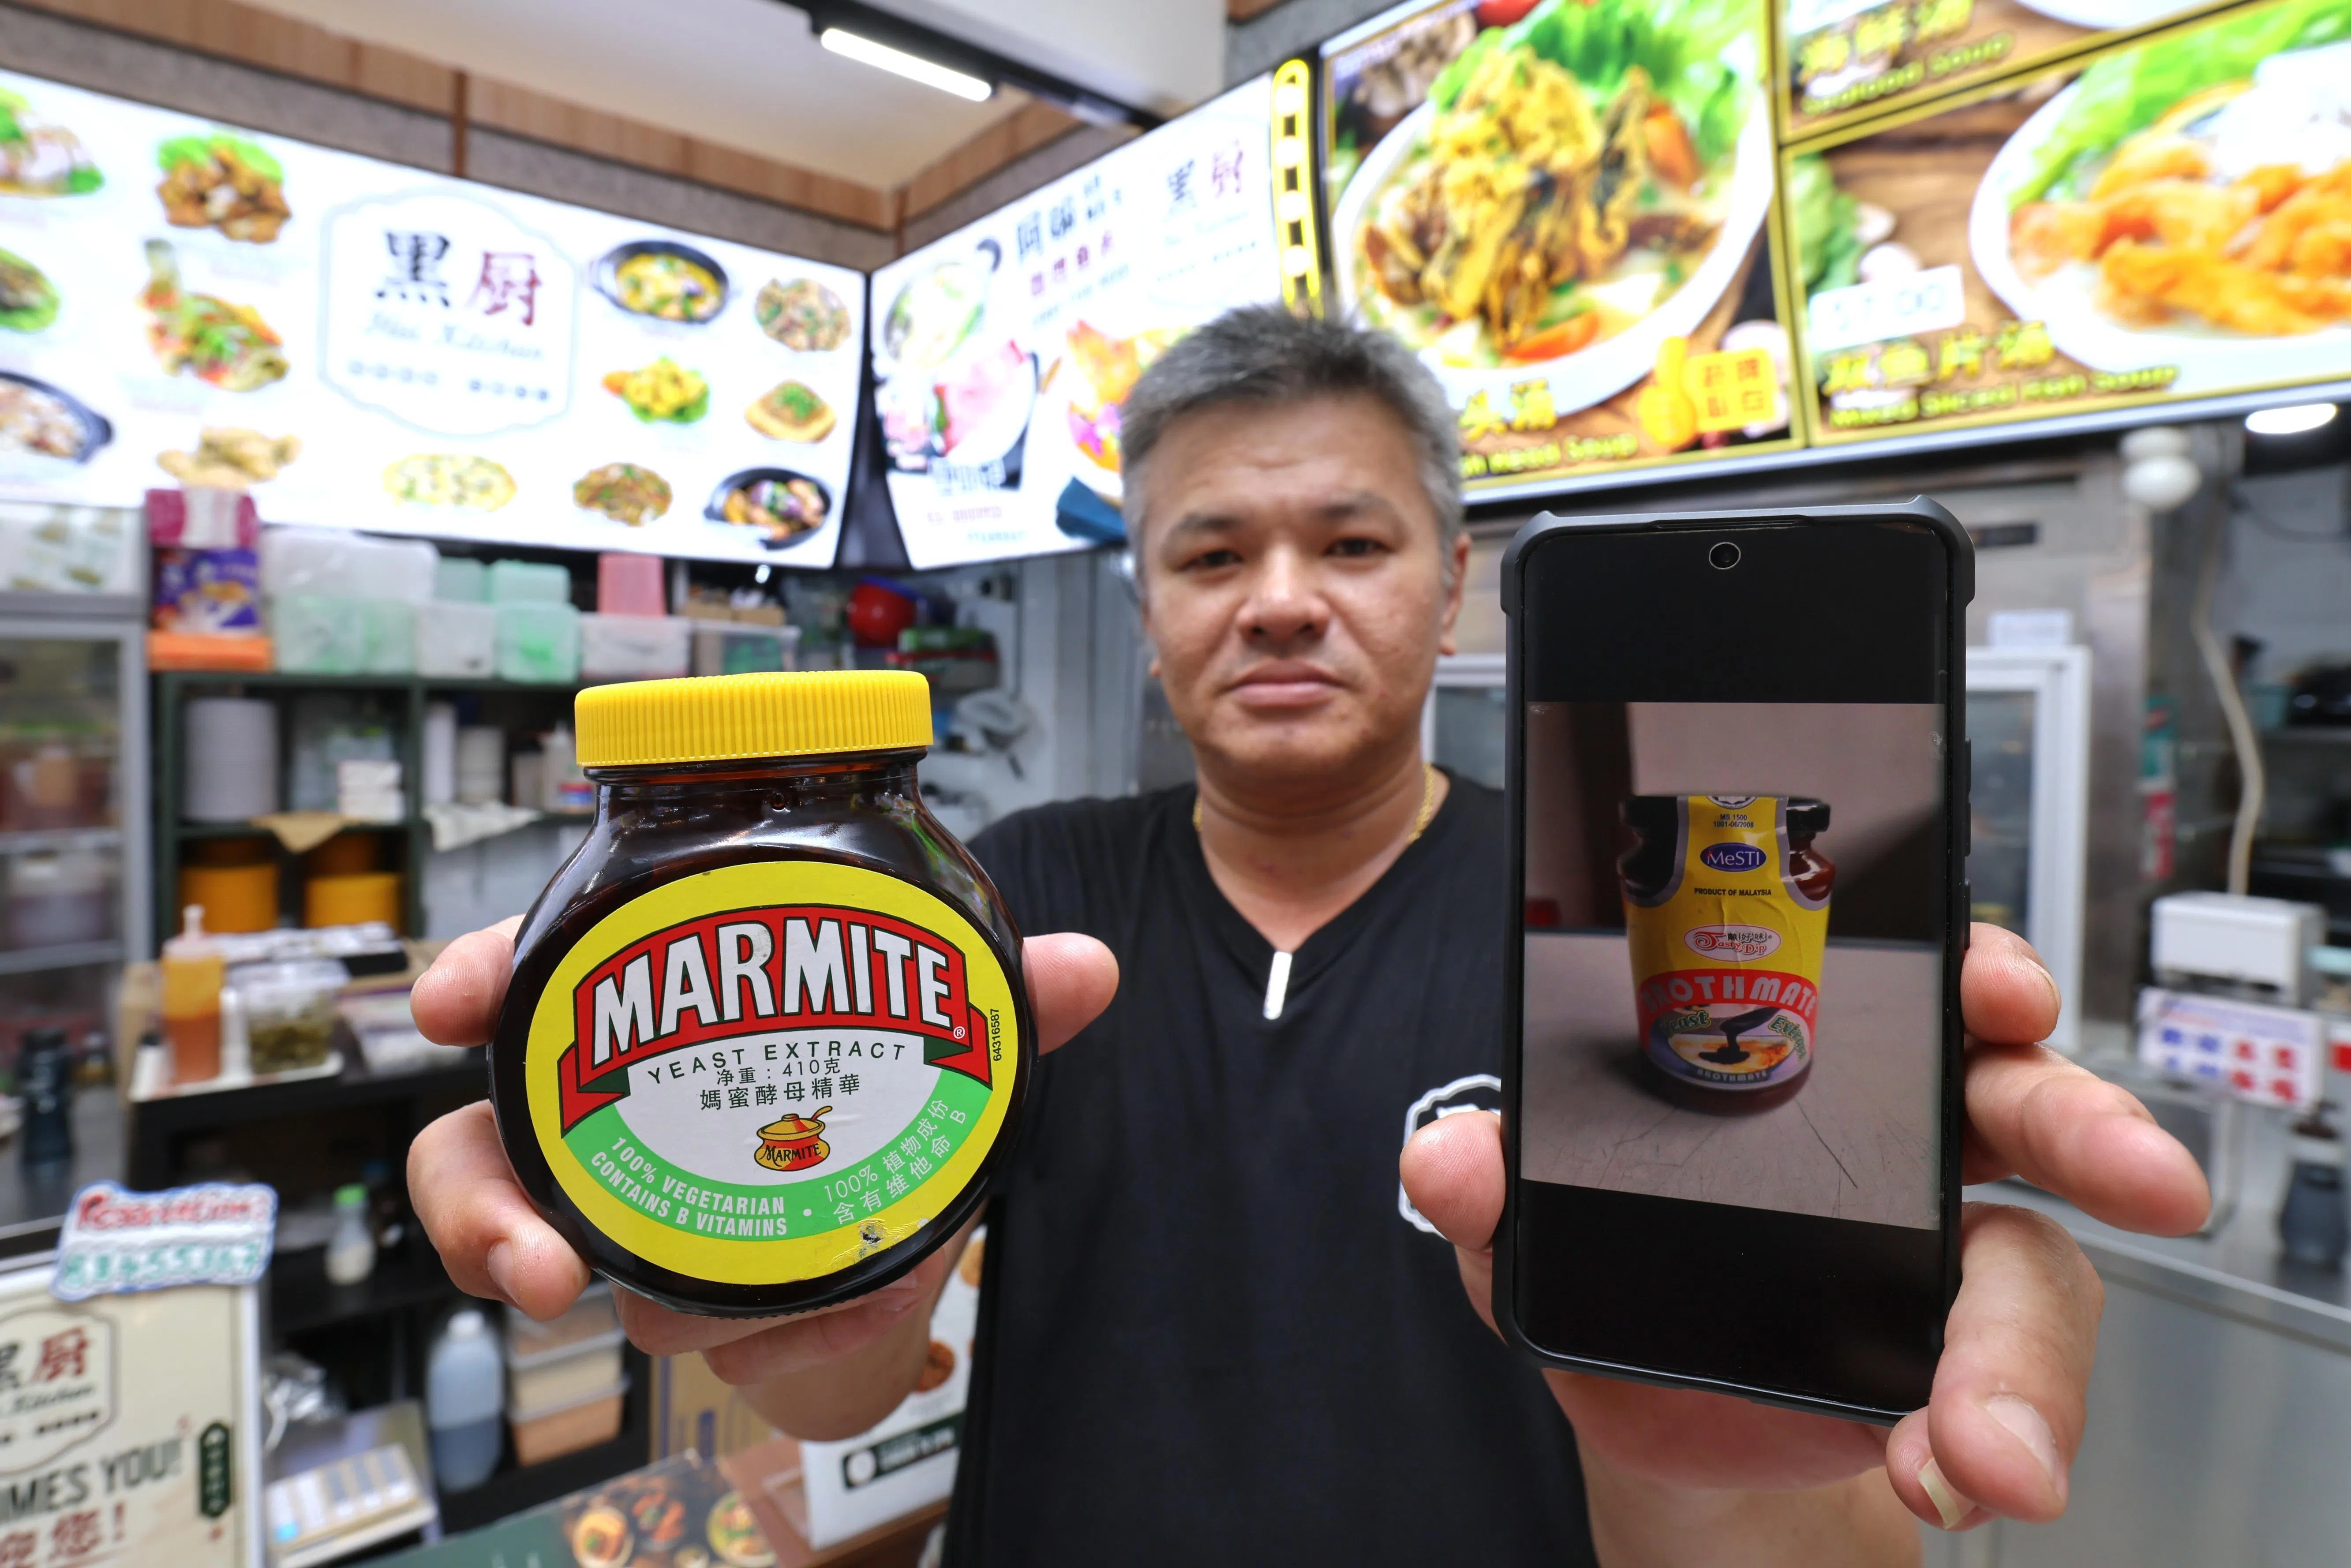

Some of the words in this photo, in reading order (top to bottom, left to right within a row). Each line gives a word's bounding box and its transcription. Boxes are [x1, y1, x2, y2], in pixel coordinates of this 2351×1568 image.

[375, 229, 544, 327] 黑厨
[1707, 851, 1760, 866] MeSTI
[1743, 943, 1766, 954] Dip
[591, 917, 952, 1067] MARMITE
[1642, 975, 1818, 1017] BROTHMATE
[990, 1009, 1002, 1061] 64316587
[648, 1048, 745, 1085] YEAST
[764, 1041, 905, 1060] EXTRACT
[700, 1074, 860, 1110] 媽蜜酵母精華
[949, 1110, 966, 1124] B
[760, 1142, 821, 1167] MARMITE
[591, 1152, 670, 1217] CONTAINS
[676, 1207, 689, 1225] B
[696, 1212, 787, 1236] VITAMINS
[612, 1137, 657, 1184] 100%
[662, 1175, 784, 1215] VEGETARIAN
[824, 1164, 879, 1202] 100%
